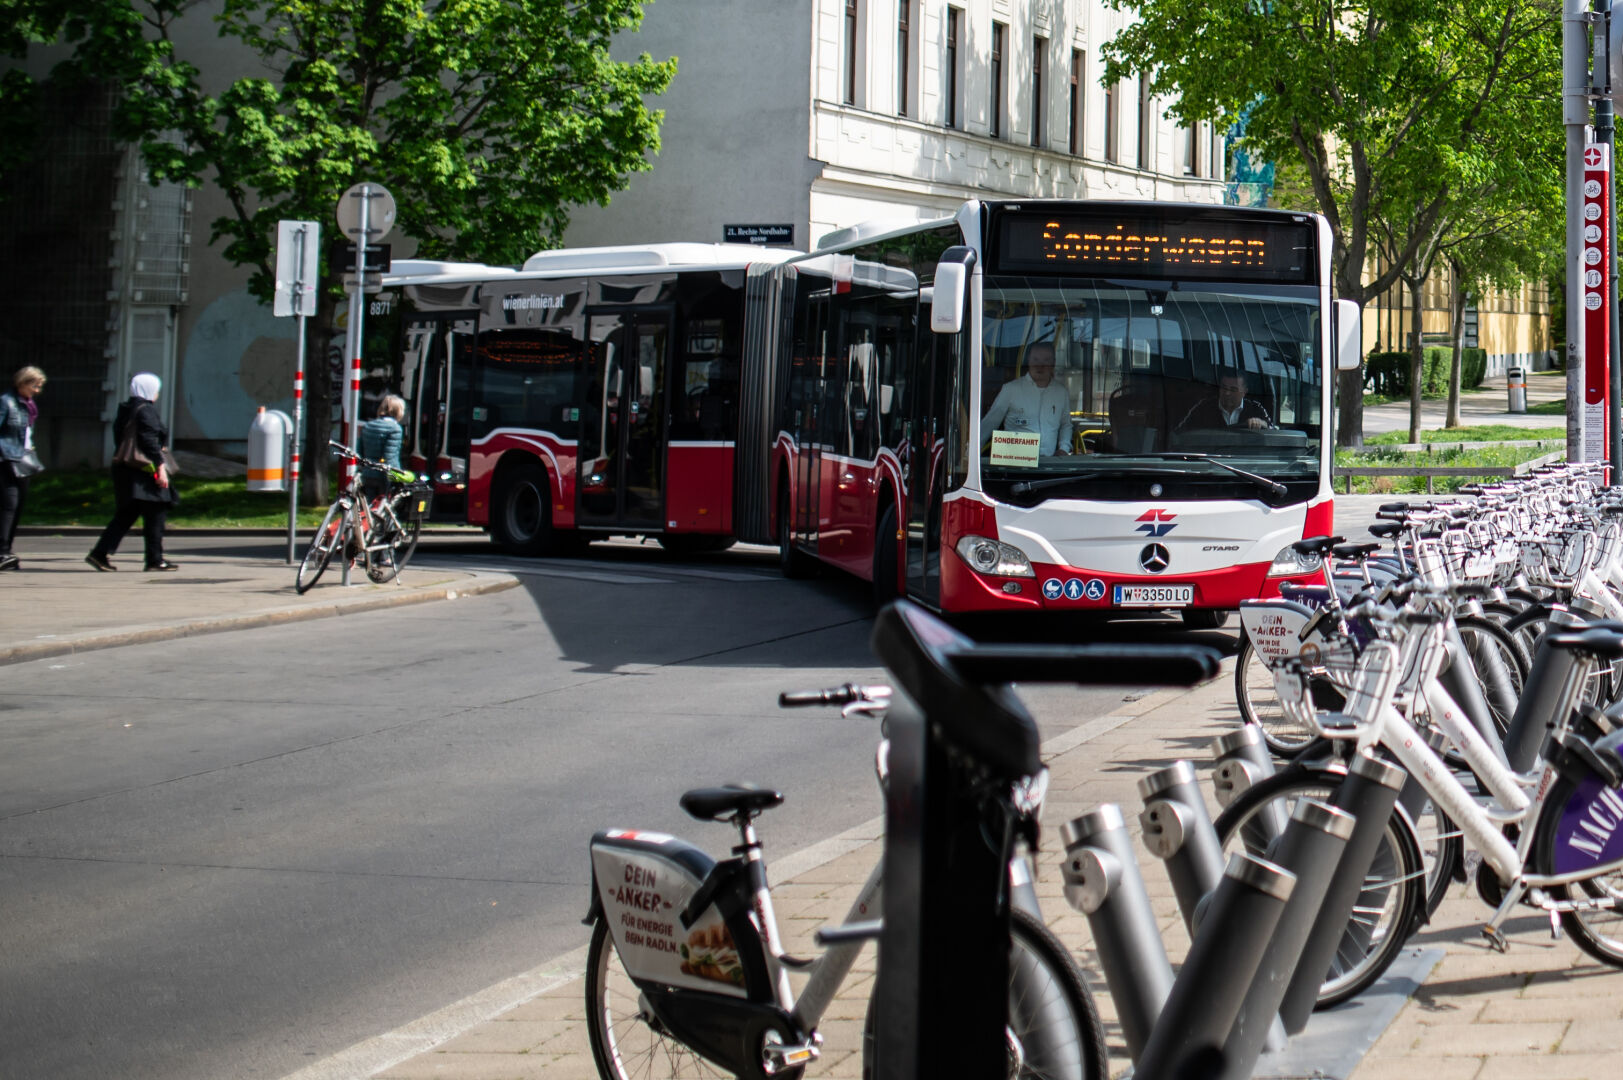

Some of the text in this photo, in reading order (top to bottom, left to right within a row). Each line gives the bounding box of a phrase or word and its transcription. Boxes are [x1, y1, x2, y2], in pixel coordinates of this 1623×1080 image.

[738, 227, 758, 236] Rechte
[1043, 222, 1265, 265] Sonderwagen
[502, 293, 565, 311] wienerlinien.at
[993, 436, 1039, 446] SONDERFAHRT
[1124, 588, 1133, 601] W
[1142, 588, 1172, 602] 3350
[1262, 615, 1283, 626] DEIN
[1271, 639, 1281, 647] DIE
[624, 864, 656, 888] DEIN
[620, 913, 674, 937] FÜR ENERGIE
[624, 929, 646, 946] BEIM
